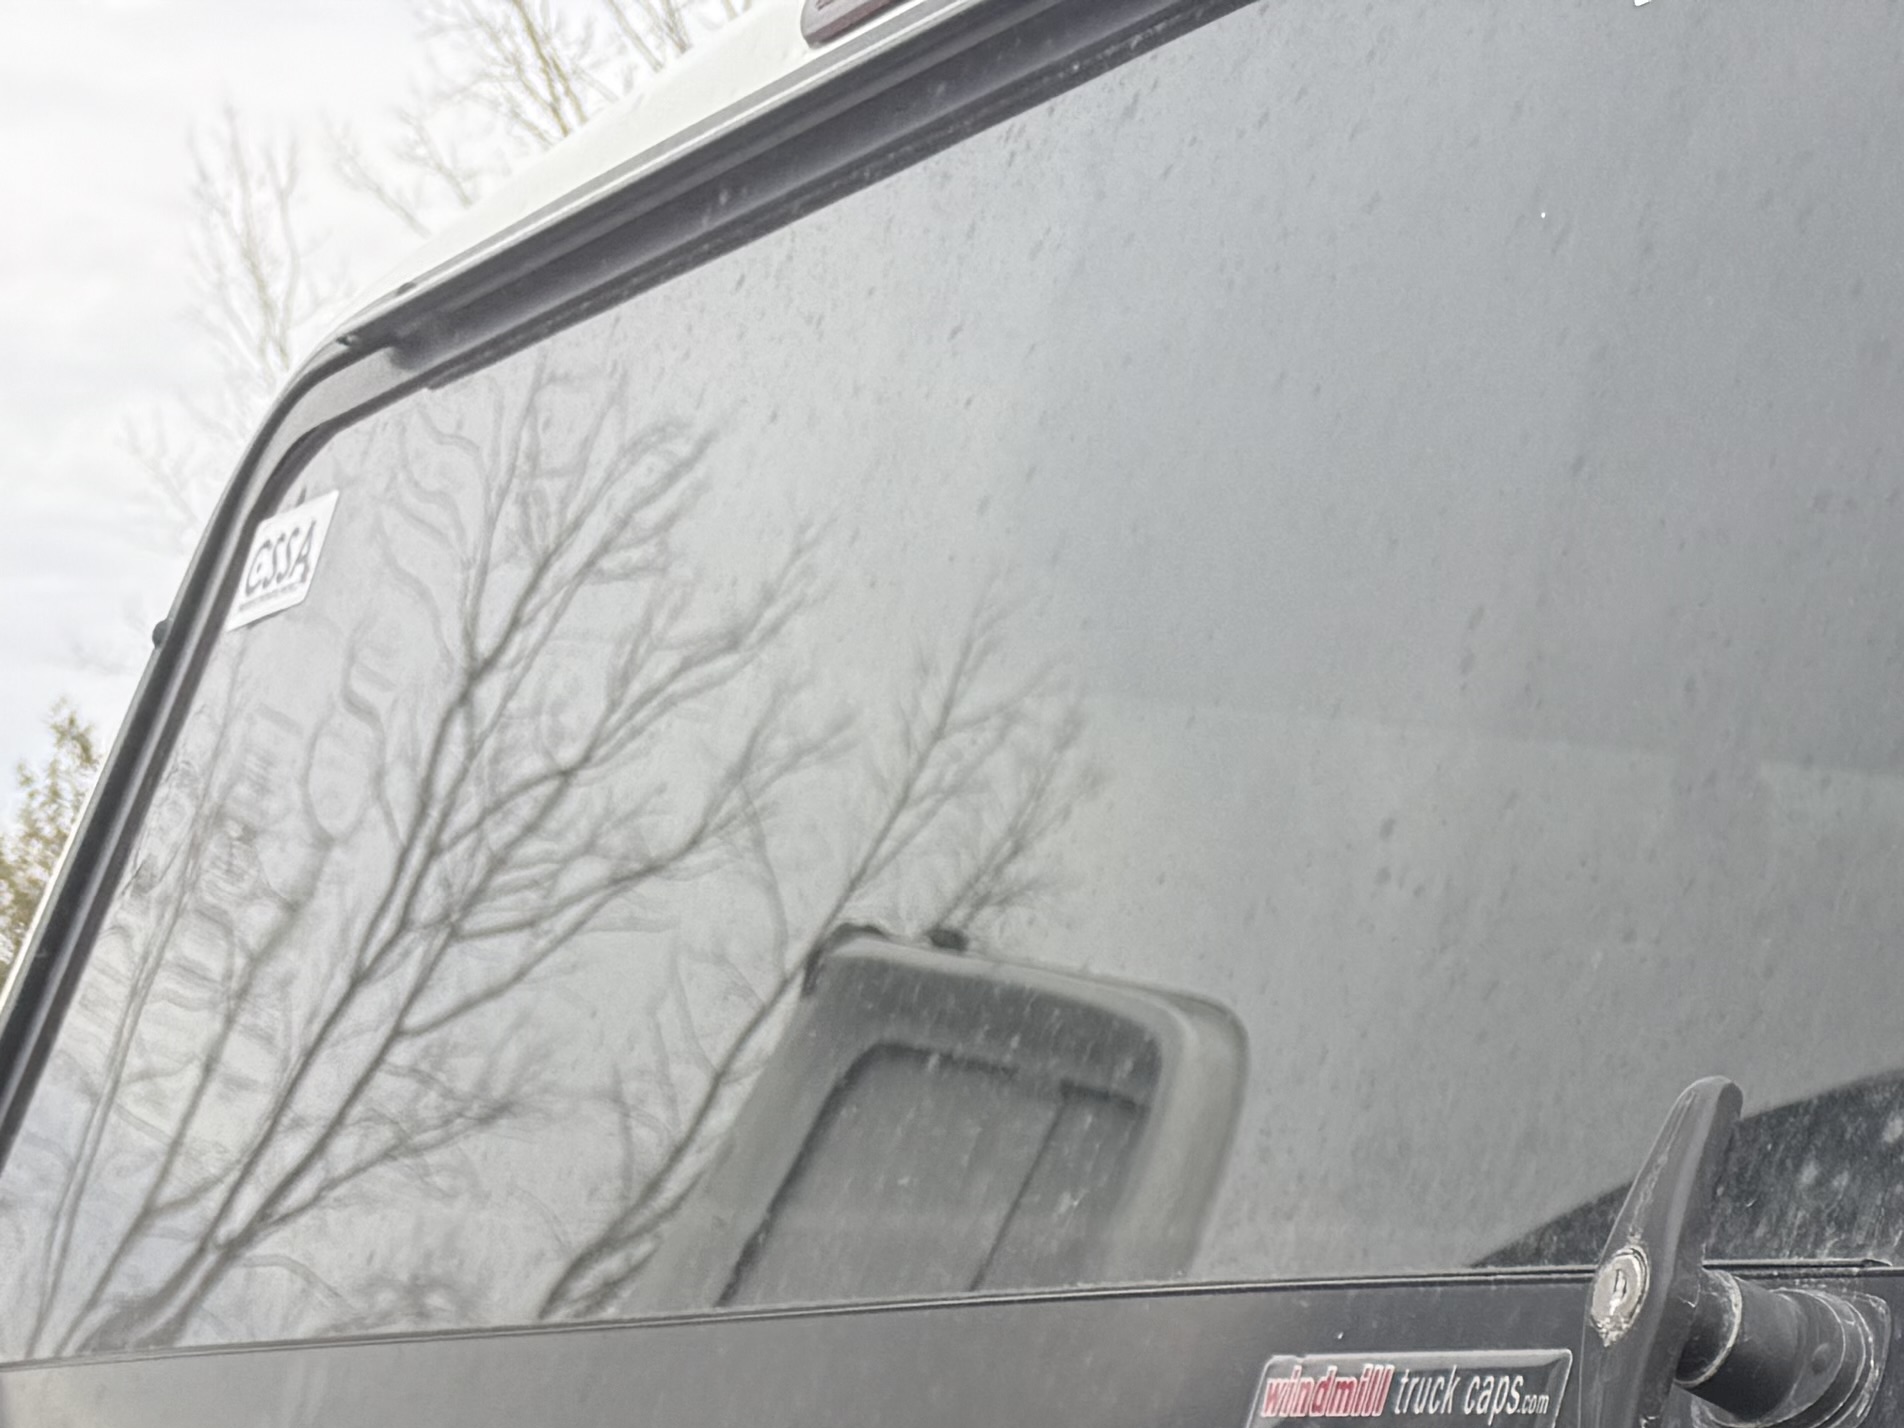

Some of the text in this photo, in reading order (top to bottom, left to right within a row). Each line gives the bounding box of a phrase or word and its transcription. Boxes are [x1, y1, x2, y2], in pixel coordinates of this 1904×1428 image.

[1260, 1363, 1550, 1426] windmill truck caps.com
